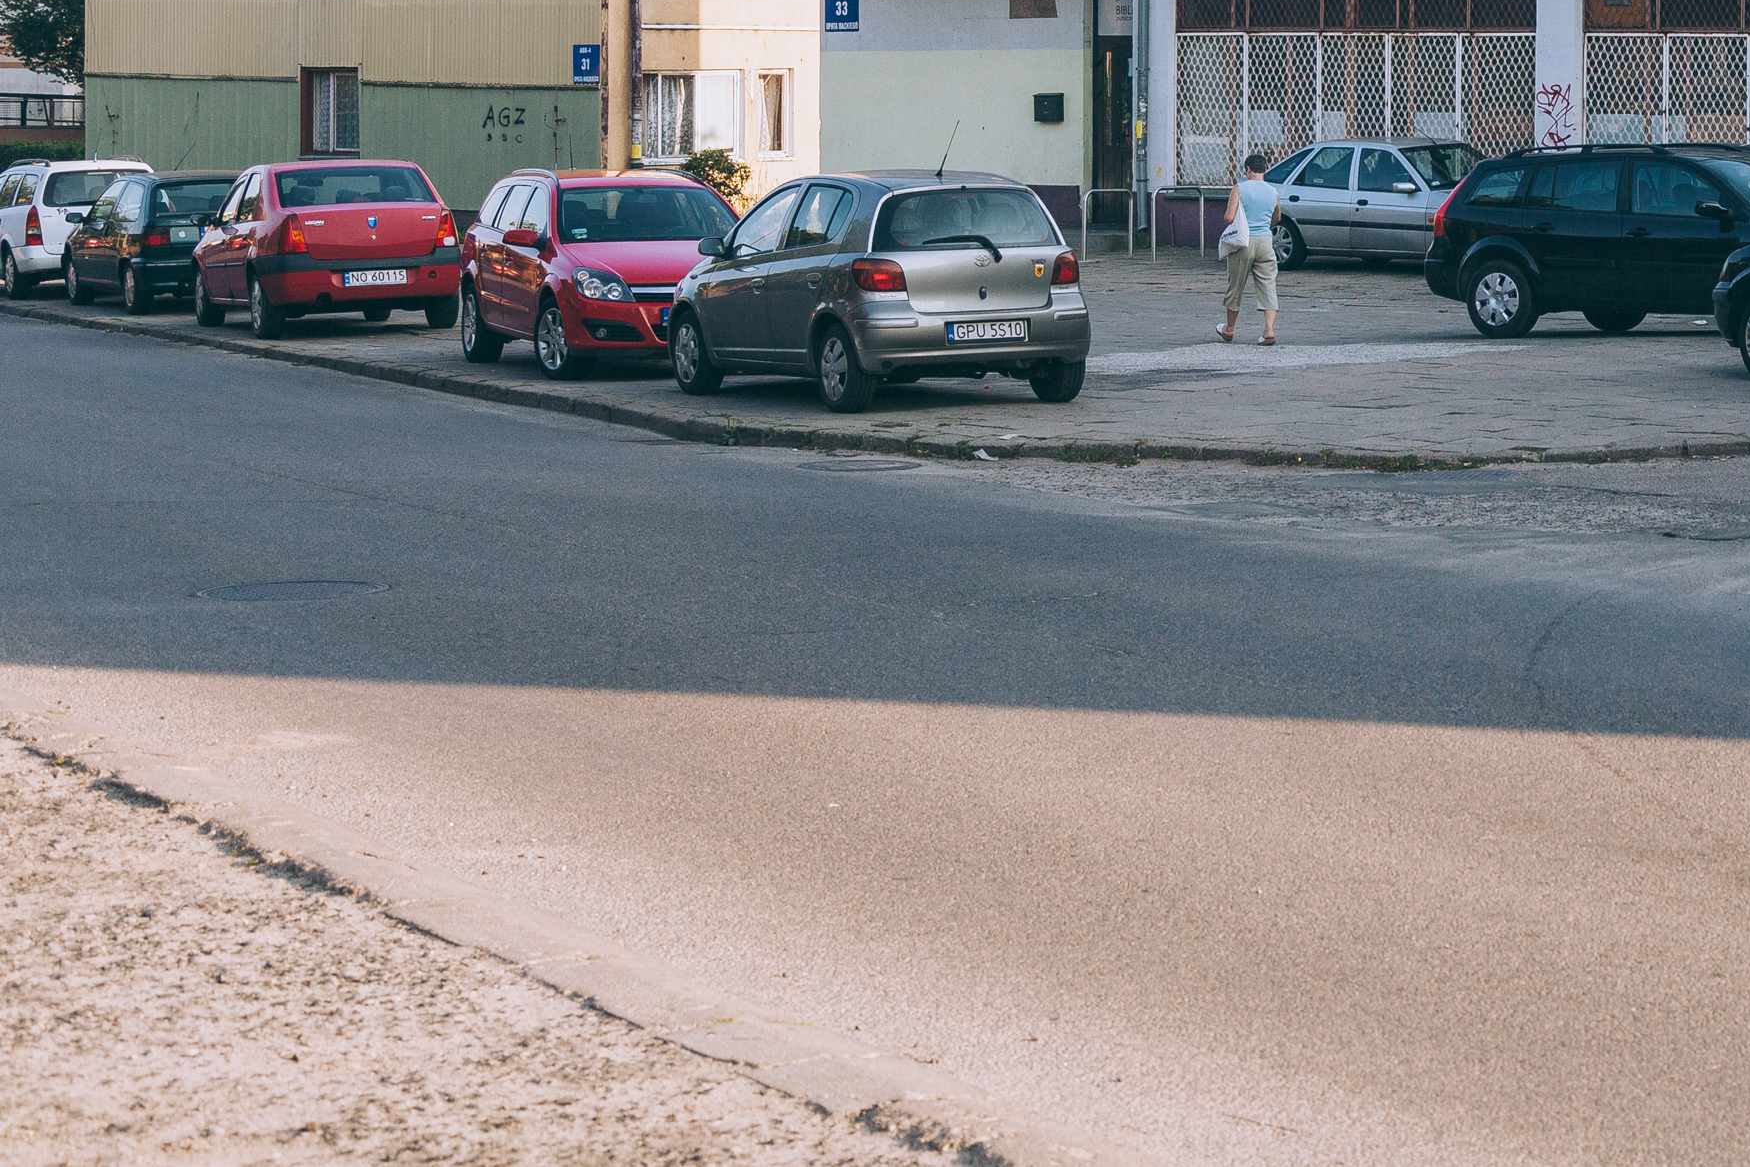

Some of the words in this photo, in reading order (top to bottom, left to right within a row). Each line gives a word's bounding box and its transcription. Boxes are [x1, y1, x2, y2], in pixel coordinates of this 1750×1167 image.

[835, 1, 848, 15] 33
[581, 58, 590, 70] 31
[482, 105, 526, 129] AGZ
[351, 272, 368, 283] NO
[371, 270, 405, 282] 60115
[956, 324, 986, 339] GPU
[990, 322, 1023, 338] 5S10
